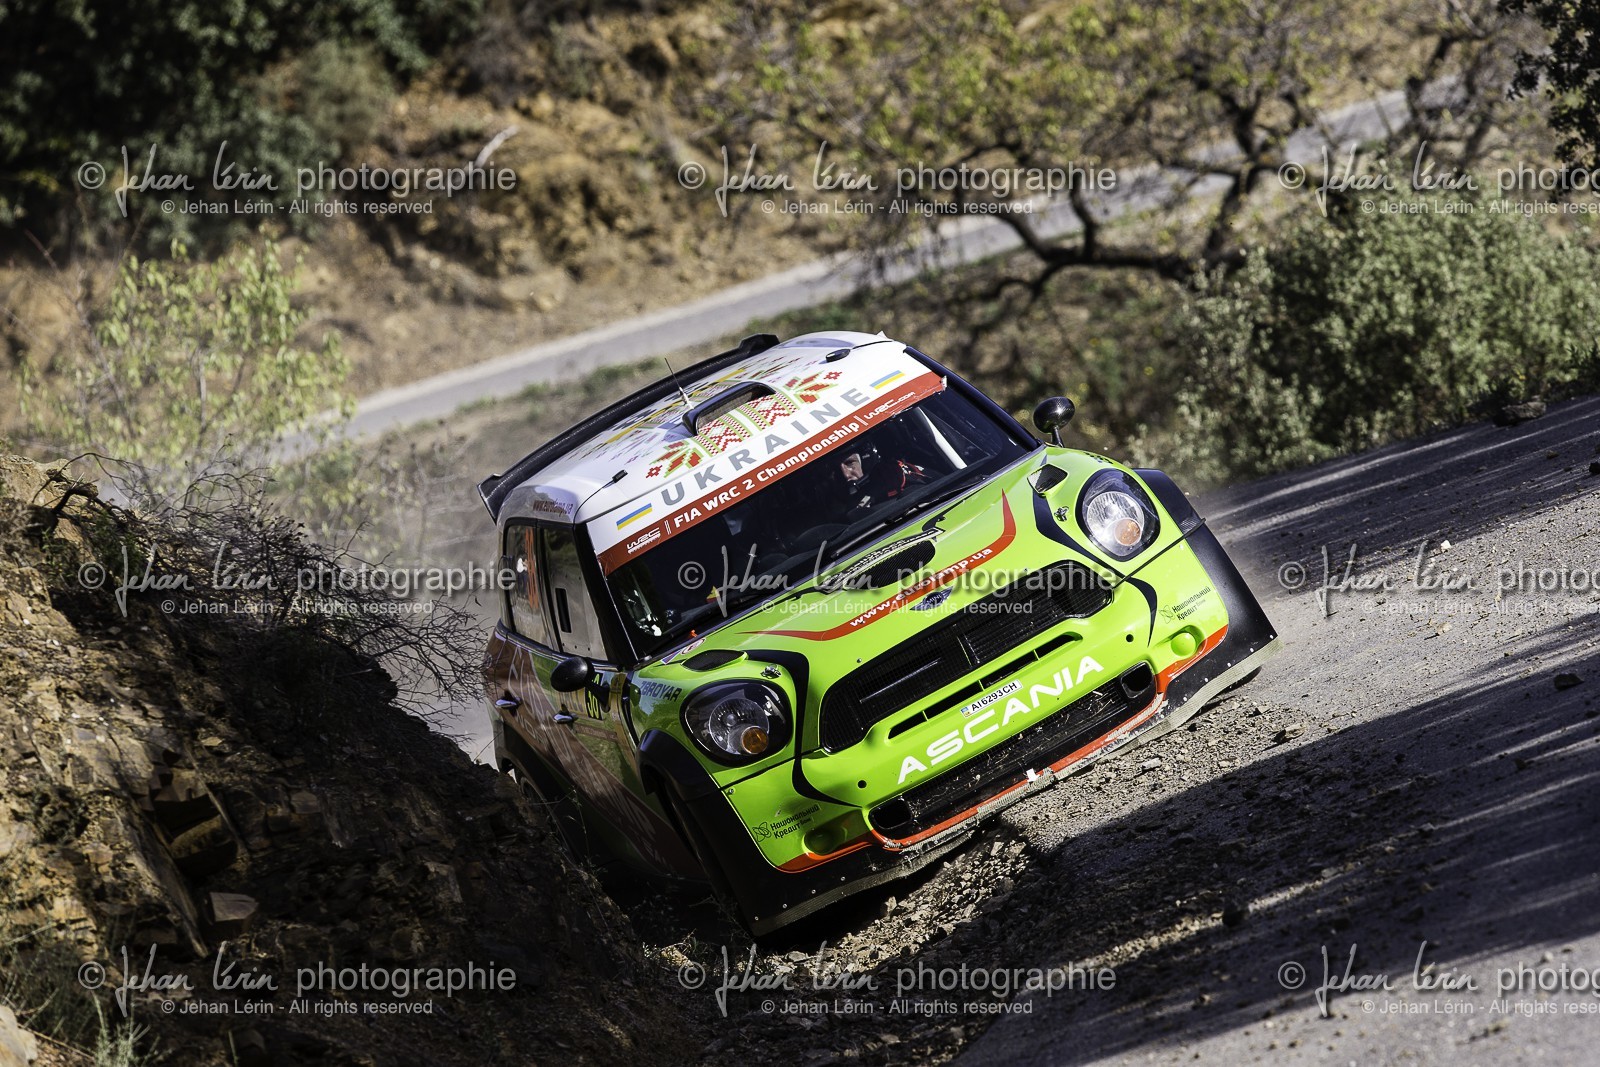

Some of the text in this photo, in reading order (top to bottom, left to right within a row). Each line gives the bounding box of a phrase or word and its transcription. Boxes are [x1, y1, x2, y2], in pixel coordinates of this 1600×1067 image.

[661, 388, 870, 506] UKRAINE
[674, 507, 701, 528] FIA
[702, 486, 741, 512] WRC
[742, 479, 755, 491] 2
[757, 421, 860, 482] Championship
[850, 548, 993, 627] www.eurolamp.ua
[897, 655, 1104, 785] ASCANIA
[971, 681, 1018, 711] AI6293CH
